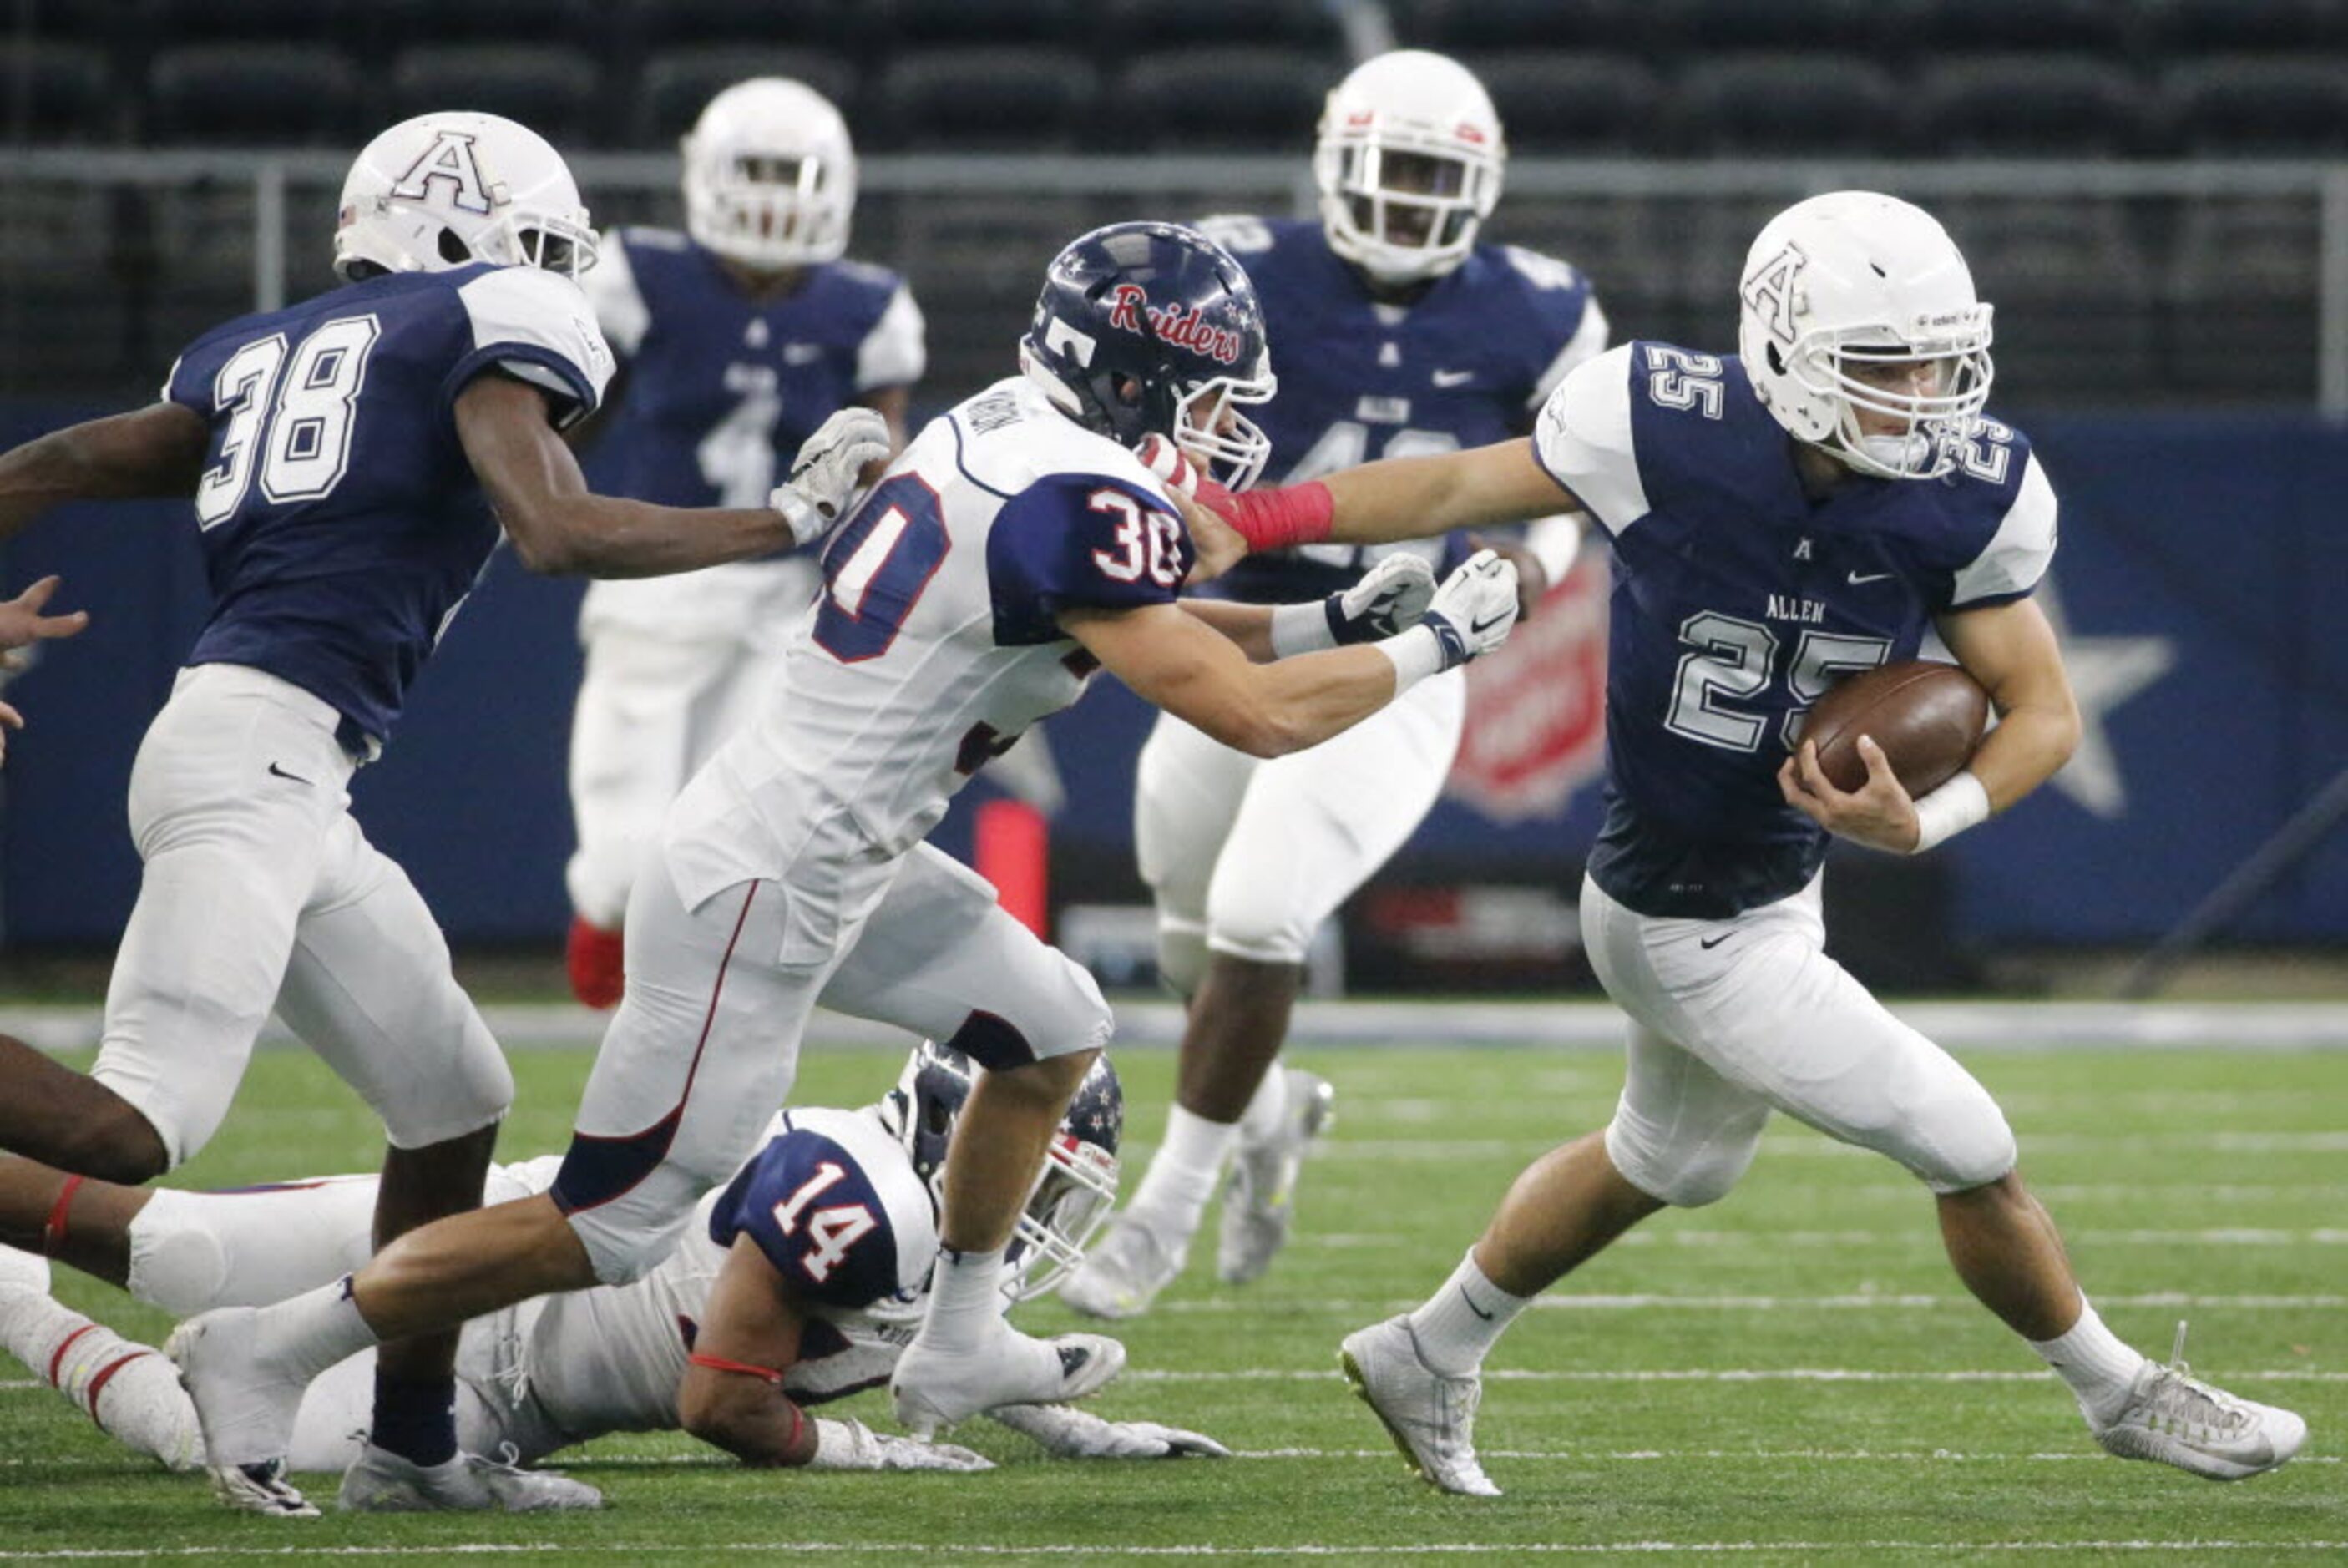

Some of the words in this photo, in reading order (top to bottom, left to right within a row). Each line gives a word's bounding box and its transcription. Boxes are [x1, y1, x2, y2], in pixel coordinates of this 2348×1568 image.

[391, 130, 491, 215] A
[1742, 240, 1807, 345] A
[195, 312, 382, 533] 38
[1644, 346, 1724, 420] 25
[808, 469, 954, 665] 0
[1087, 486, 1182, 588] 30
[1794, 537, 1814, 560] A
[1765, 594, 1826, 624] ALLEN
[1664, 609, 1895, 753] 25
[772, 1160, 878, 1283] 14
